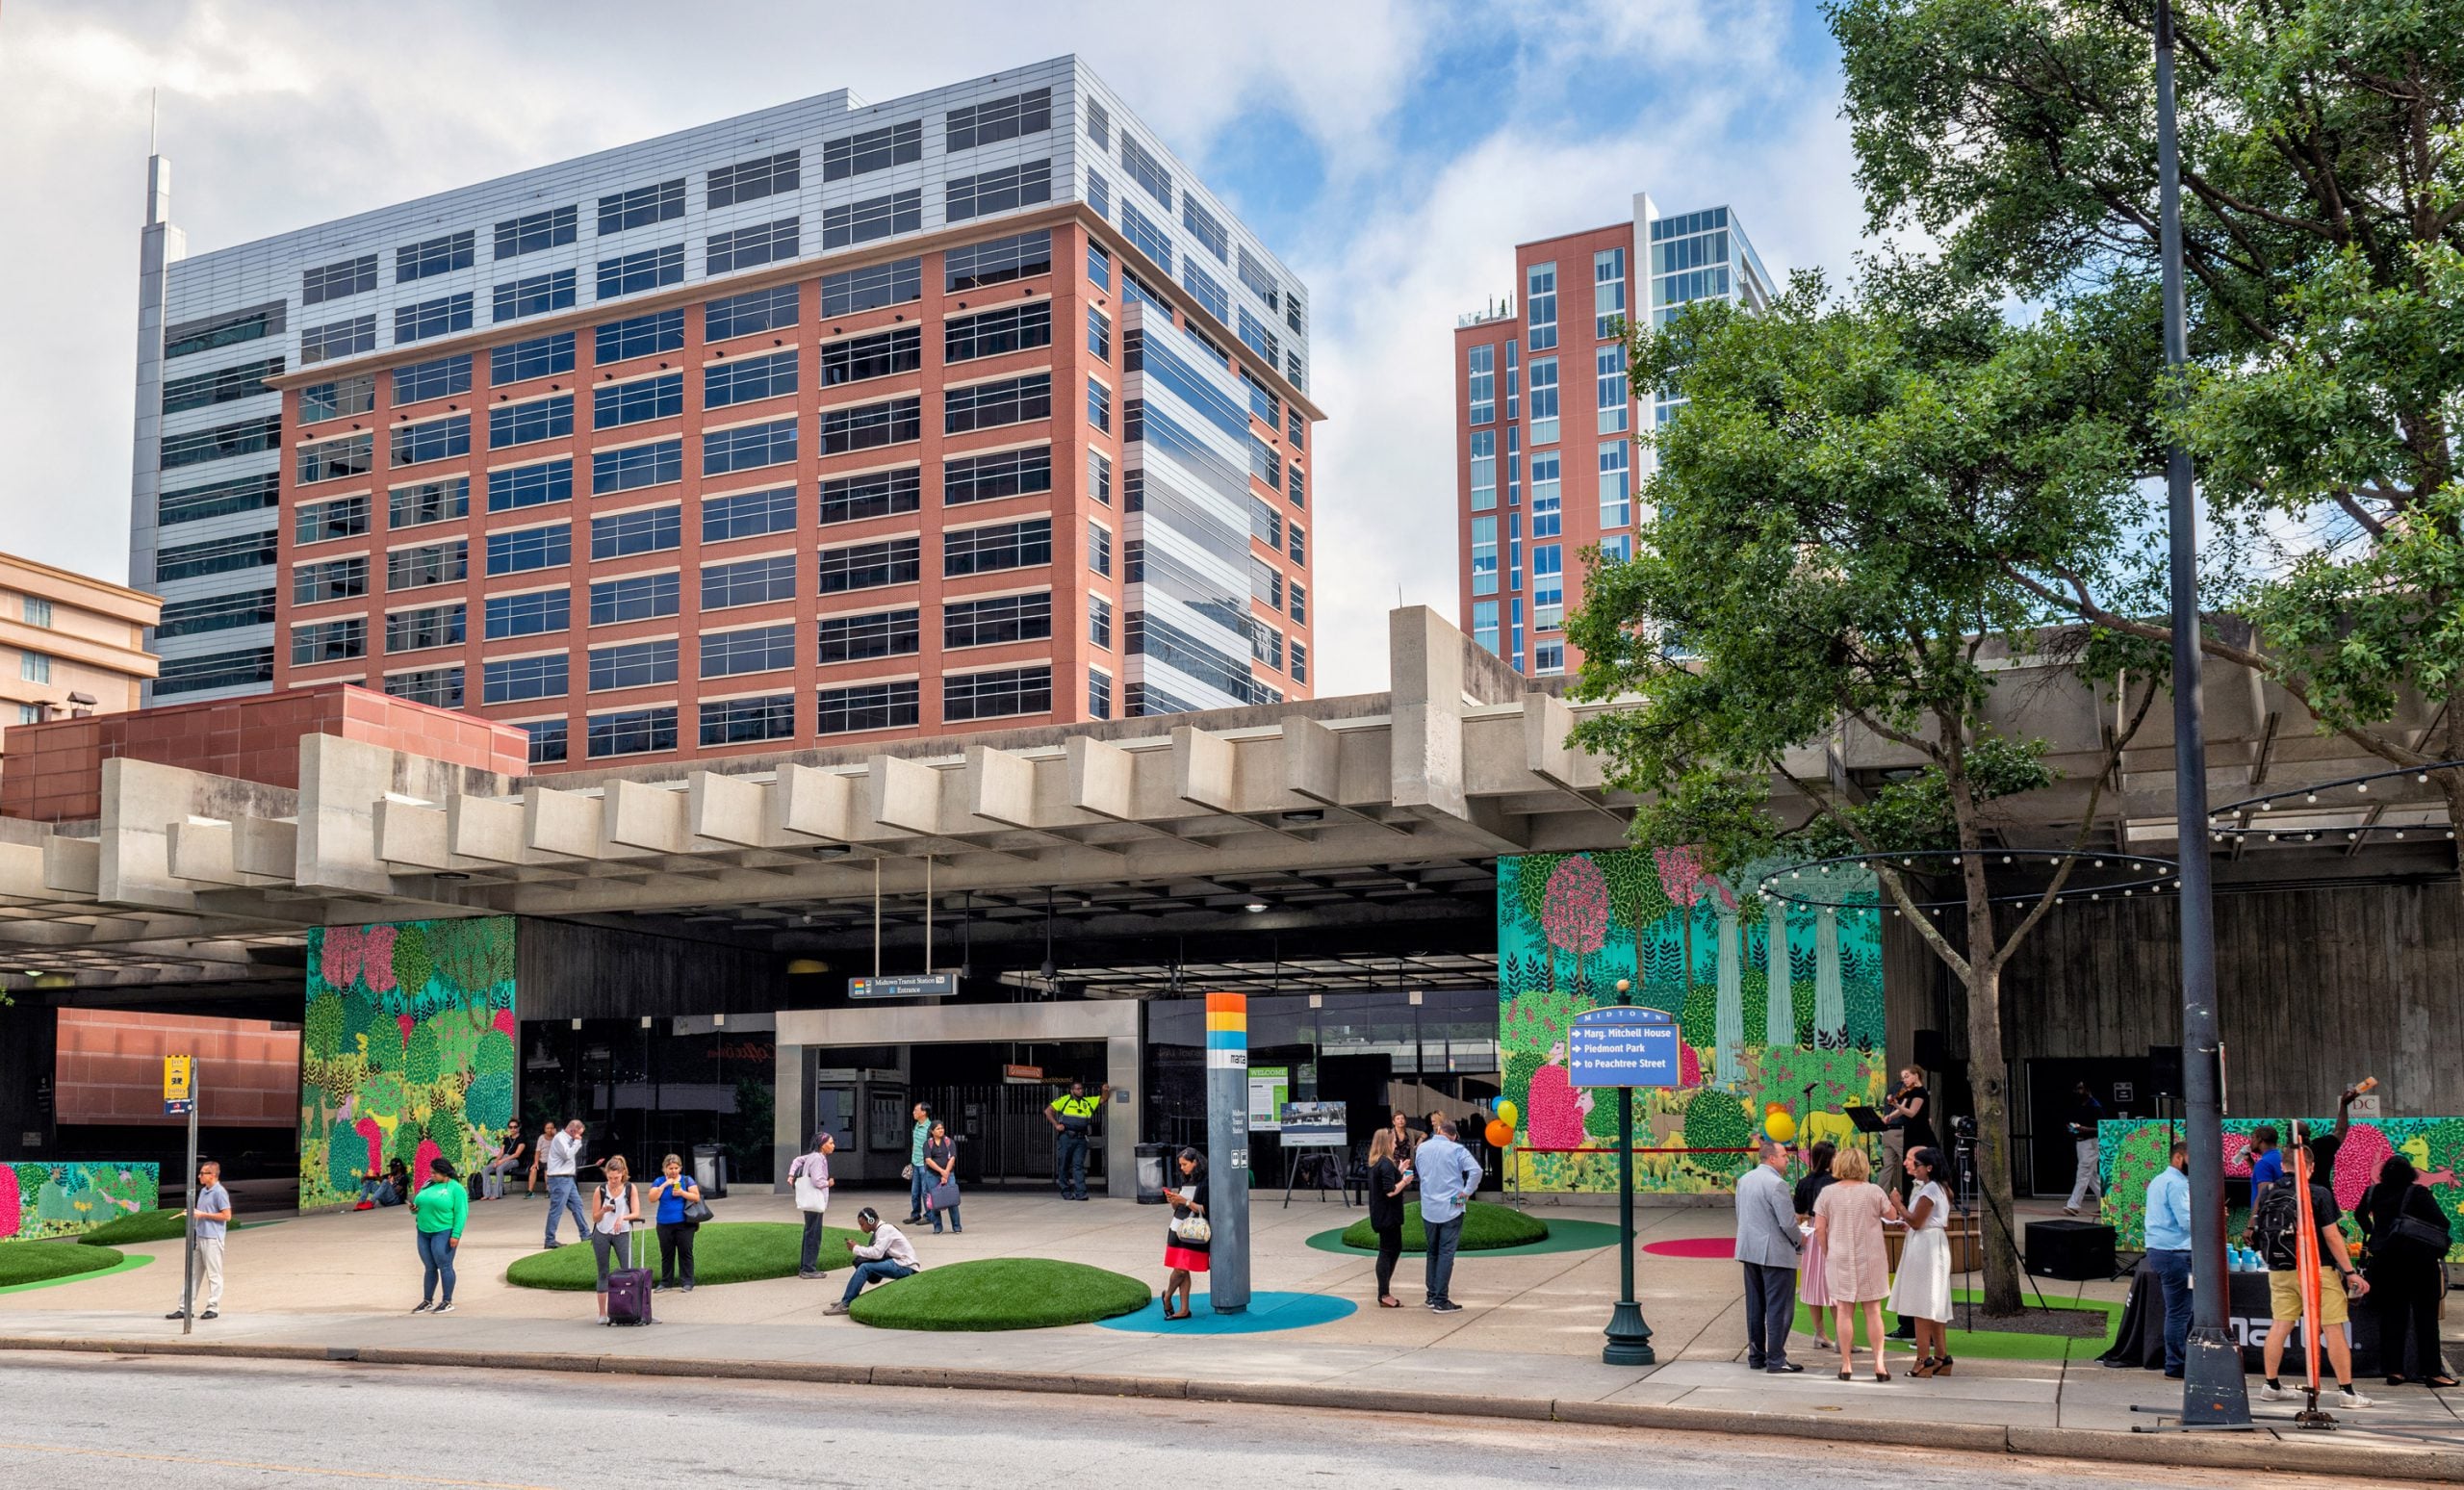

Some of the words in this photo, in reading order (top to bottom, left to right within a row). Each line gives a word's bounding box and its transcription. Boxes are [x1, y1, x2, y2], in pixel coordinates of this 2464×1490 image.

[1584, 1011, 1661, 1021] MIDTOWN
[1584, 1029, 1606, 1040] Marg.
[1608, 1028, 1642, 1038] Mitchell
[1644, 1028, 1672, 1038] House
[1584, 1043, 1624, 1053] Piedmont
[1626, 1043, 1645, 1053] Park
[1595, 1060, 1637, 1068] Peachtree
[1639, 1060, 1666, 1068] Street
